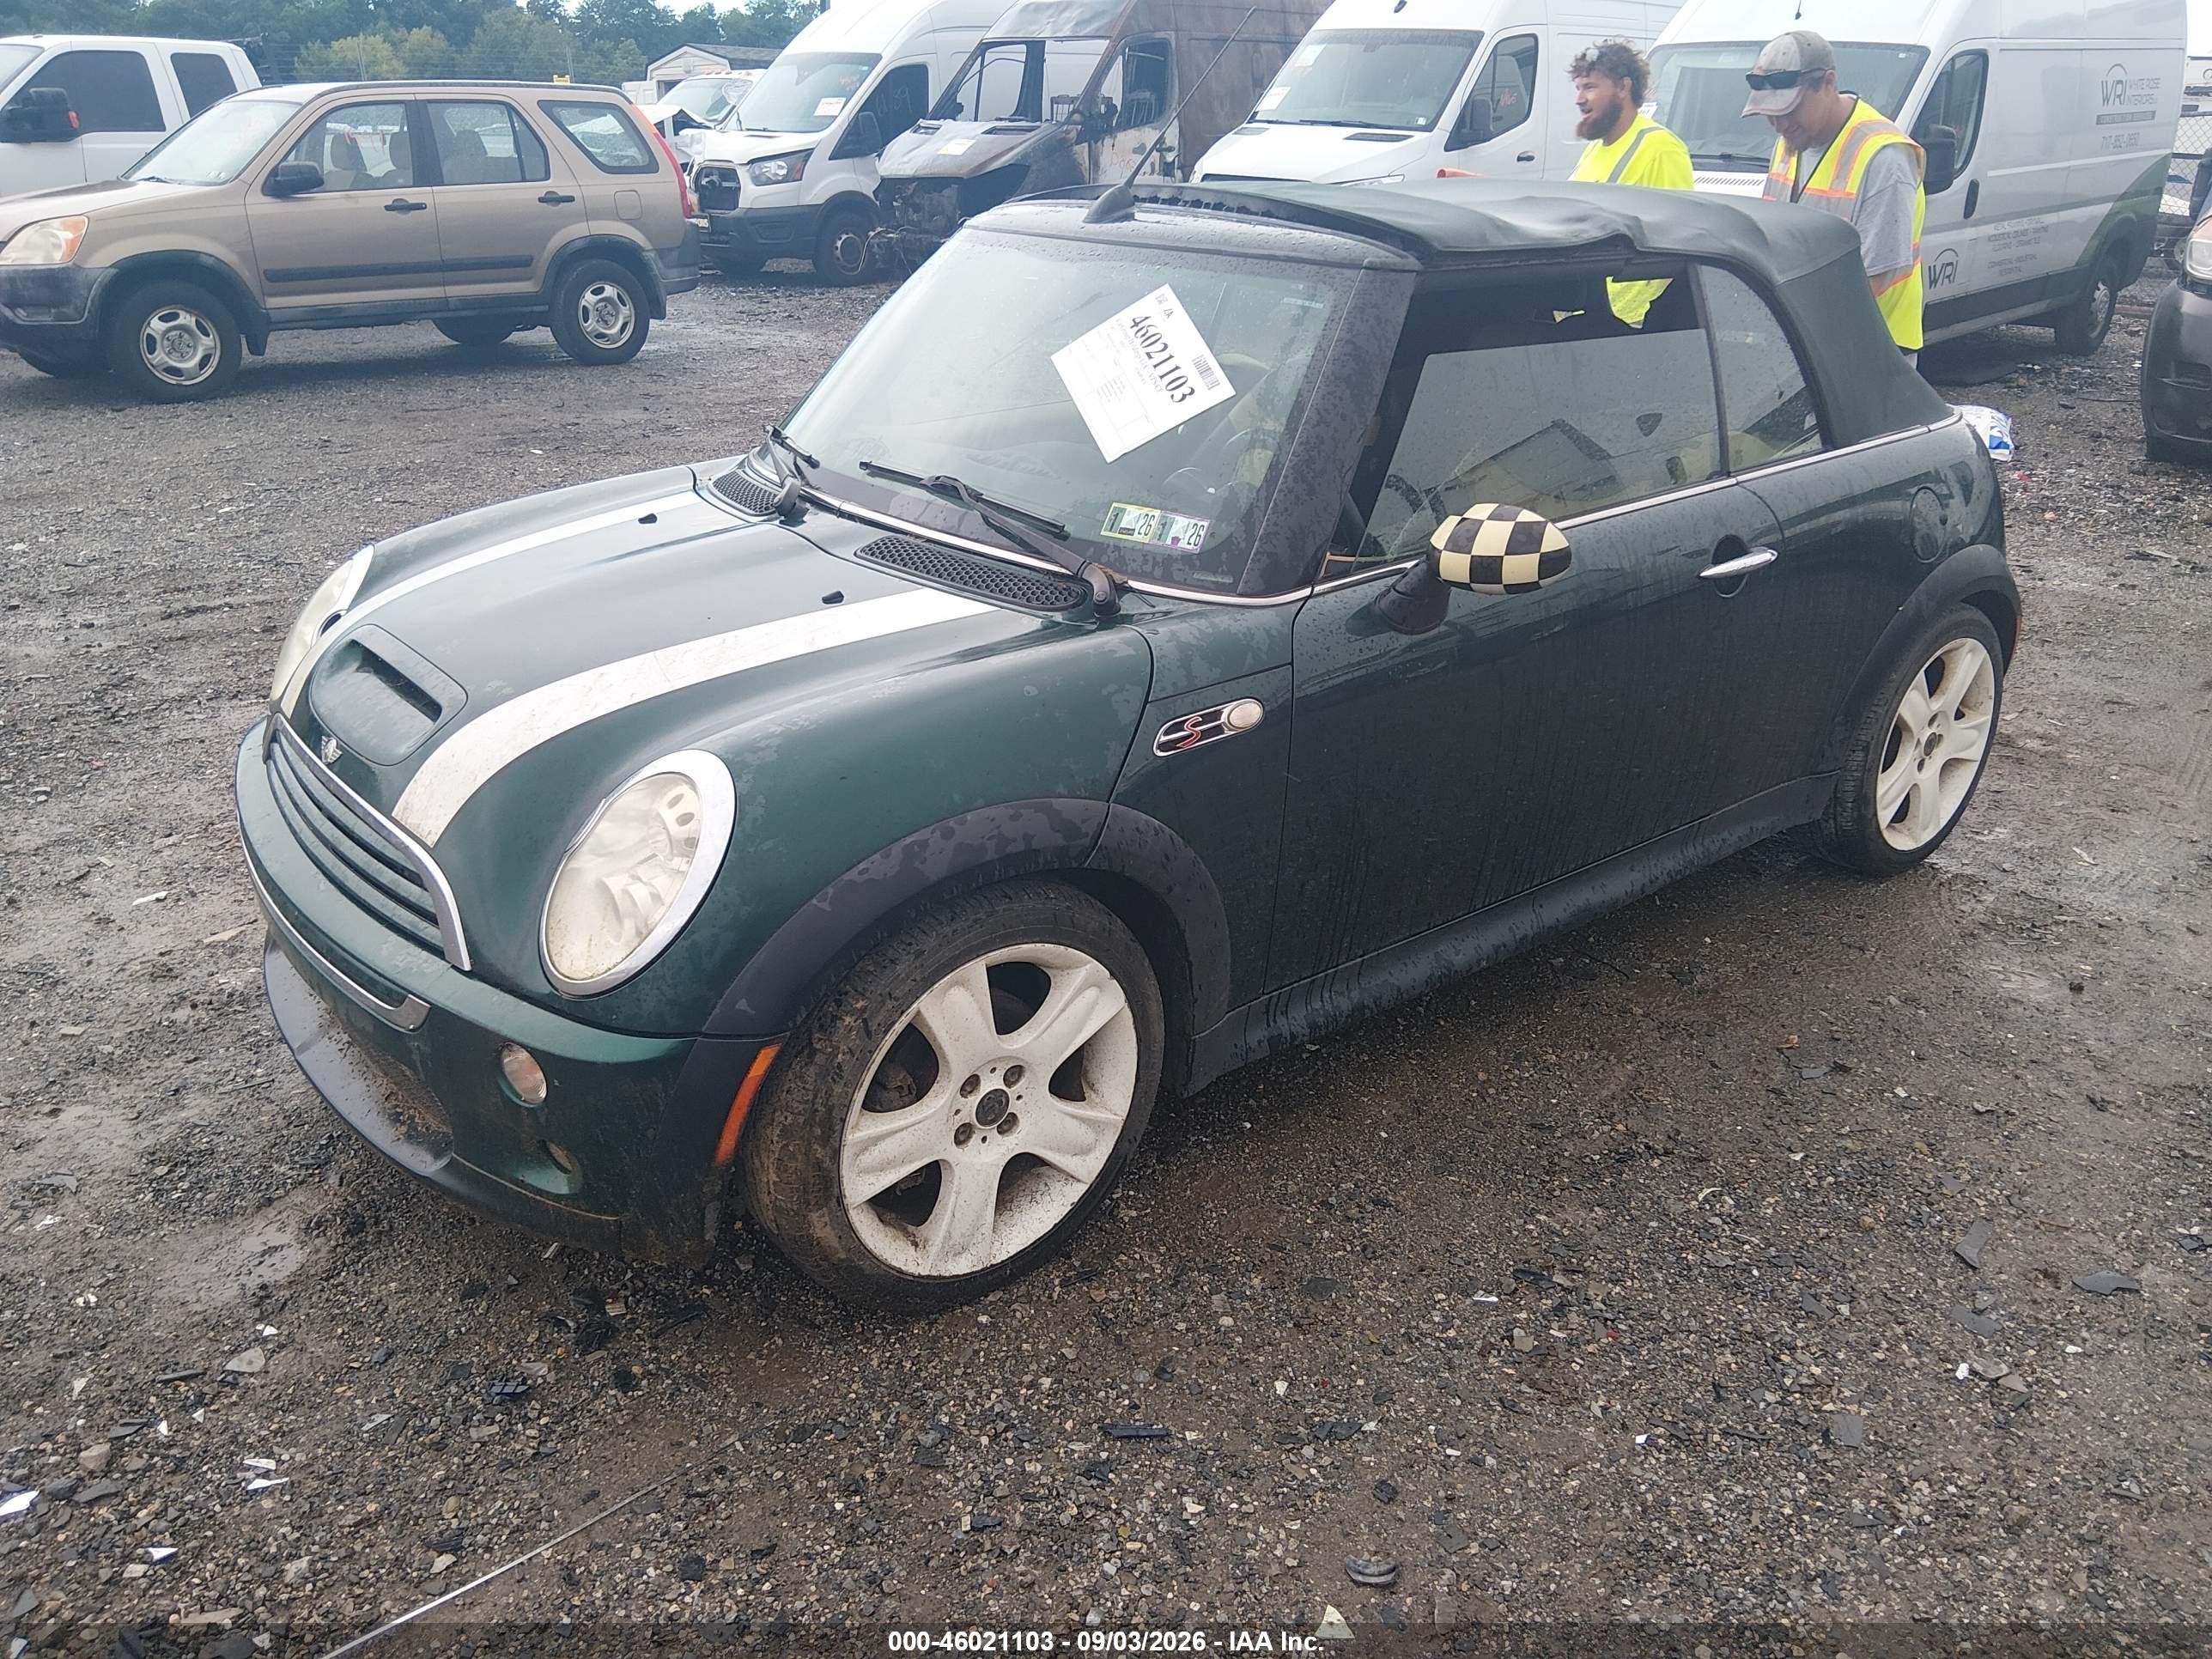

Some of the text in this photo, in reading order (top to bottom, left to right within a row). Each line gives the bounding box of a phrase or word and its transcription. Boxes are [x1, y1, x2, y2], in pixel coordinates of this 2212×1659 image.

[2101, 79, 2128, 106] WRI
[1928, 260, 1958, 289] WRI
[1130, 315, 1195, 404] 46021103
[1138, 514, 1156, 537] 26
[1187, 523, 1206, 547] 26
[1176, 715, 1202, 749] S
